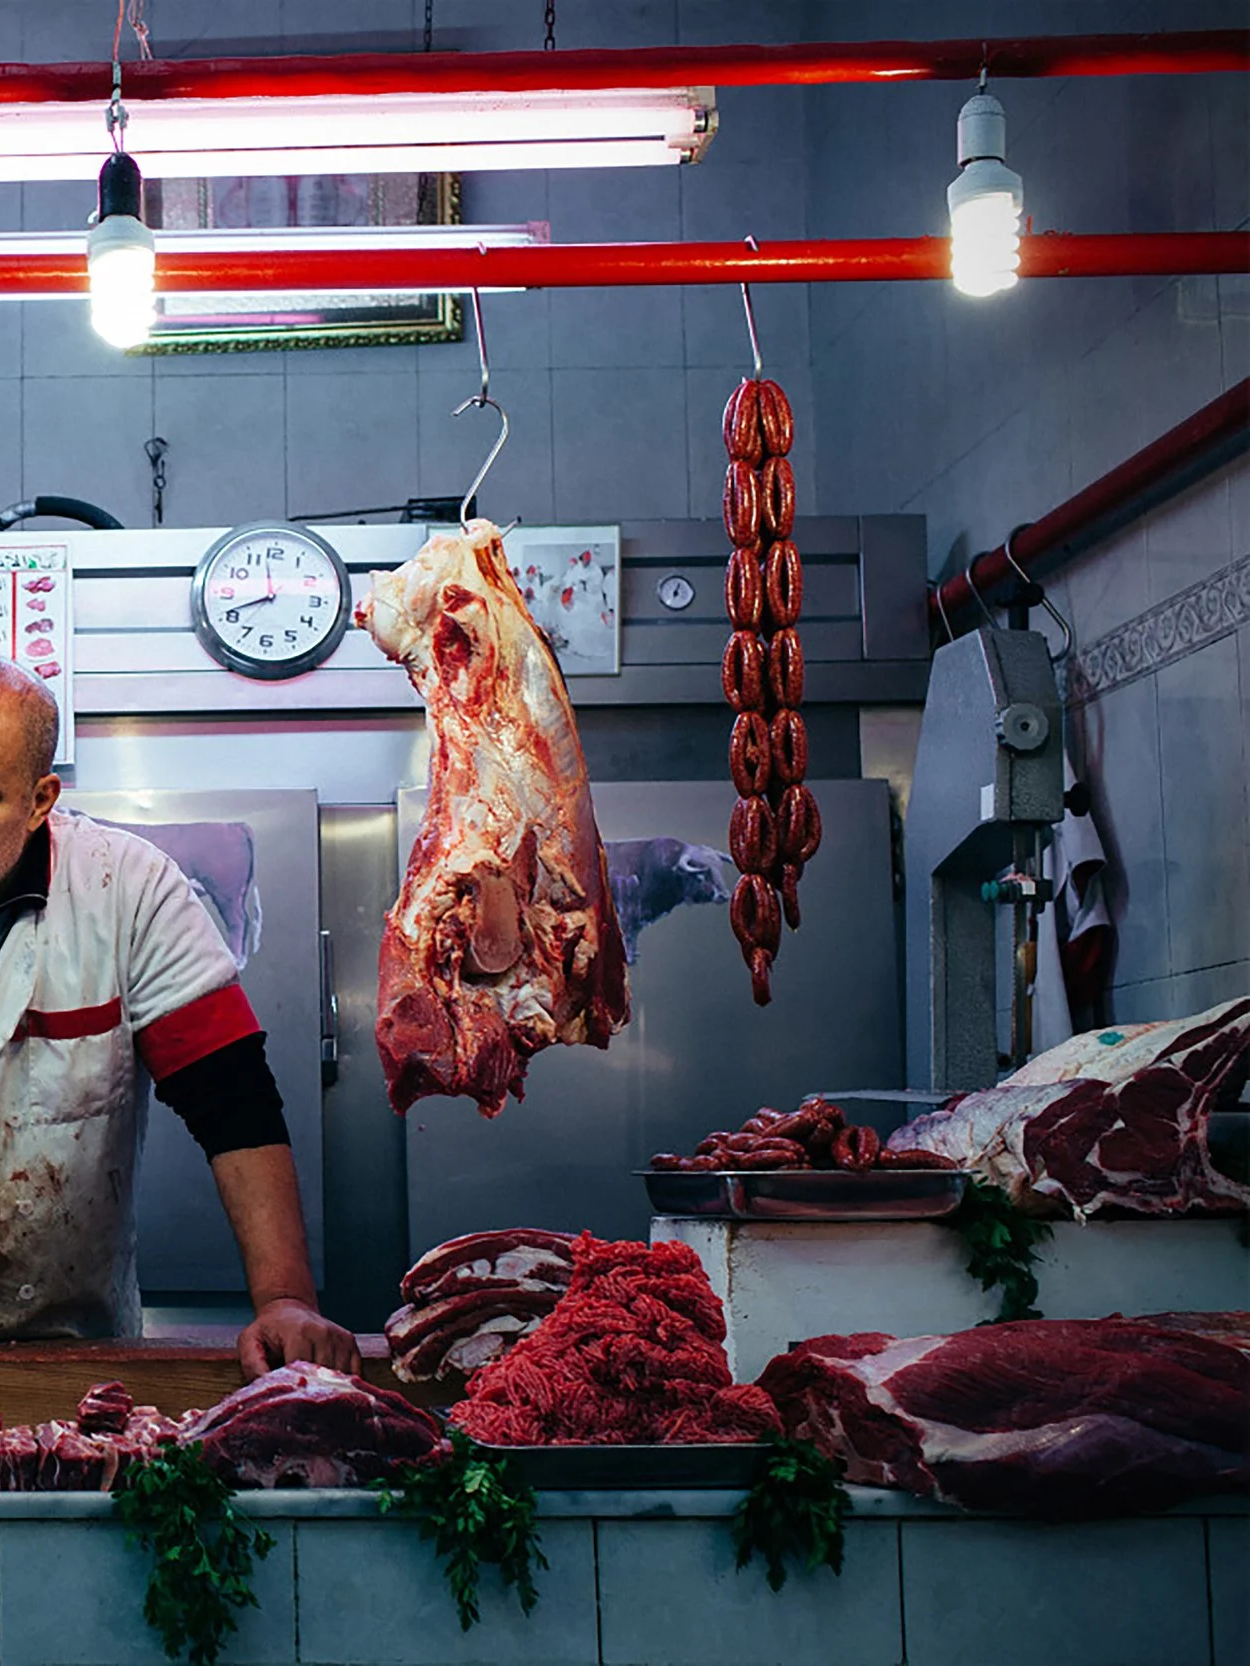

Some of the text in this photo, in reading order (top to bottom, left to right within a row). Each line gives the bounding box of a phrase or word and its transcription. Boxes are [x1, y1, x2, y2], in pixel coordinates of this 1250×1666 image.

[247, 553, 262, 566] 11
[266, 547, 285, 561] 12
[295, 556, 301, 568] 1
[230, 567, 249, 580] 10
[303, 575, 318, 588] 2
[219, 586, 235, 600] 9
[308, 595, 322, 608] 3
[226, 610, 240, 624] 8
[300, 616, 314, 628] 4
[241, 626, 254, 639] 7
[284, 630, 298, 643] 5
[259, 634, 274, 648] 6
